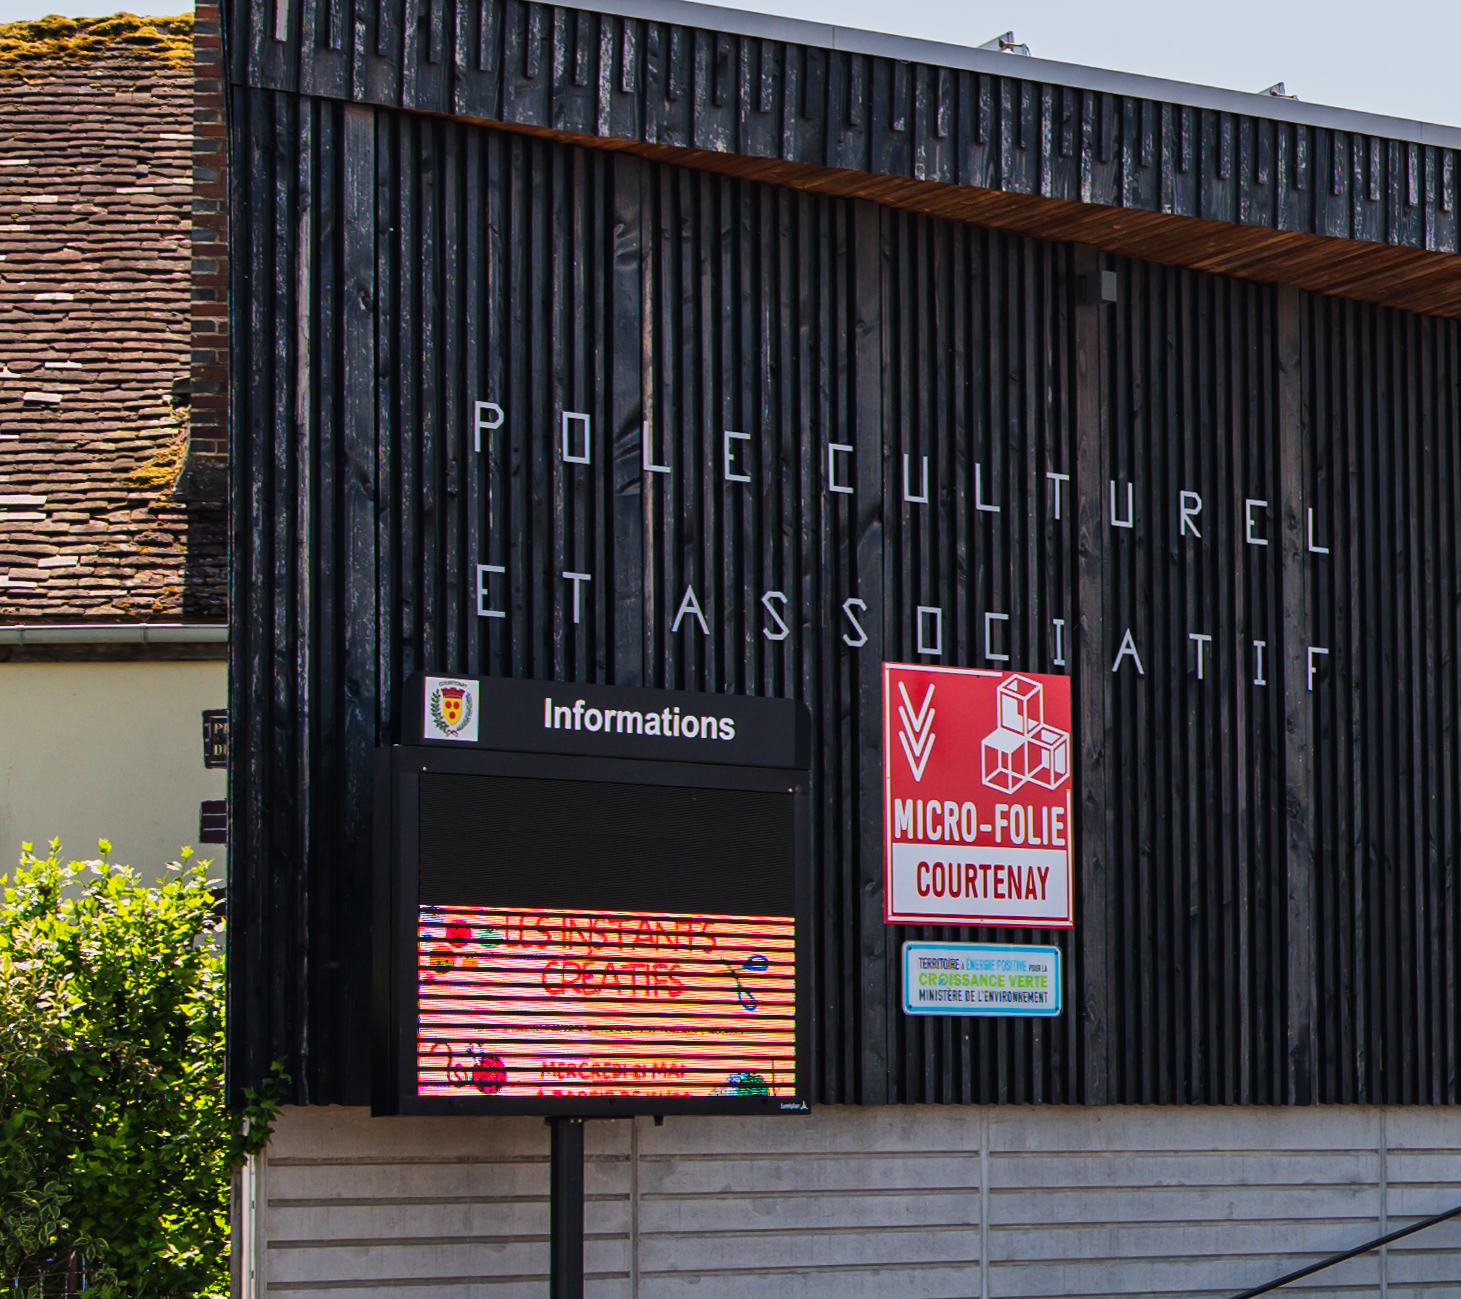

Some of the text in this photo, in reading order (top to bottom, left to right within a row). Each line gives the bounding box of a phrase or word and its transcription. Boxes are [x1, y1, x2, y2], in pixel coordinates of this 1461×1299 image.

[474, 400, 1329, 554] POLE CULTUREL
[476, 563, 1329, 691] ET ASSOCIATIF
[543, 697, 736, 741] Informations
[893, 798, 1066, 846] MICRO-FOLIE
[916, 861, 1050, 901] COURTENAY
[918, 957, 960, 970] TERRITOIRE
[918, 972, 1048, 989] CROISSANCE VERTE
[918, 987, 1049, 1004] MINISTÈRE DE L'ENVIRONNEMENT
